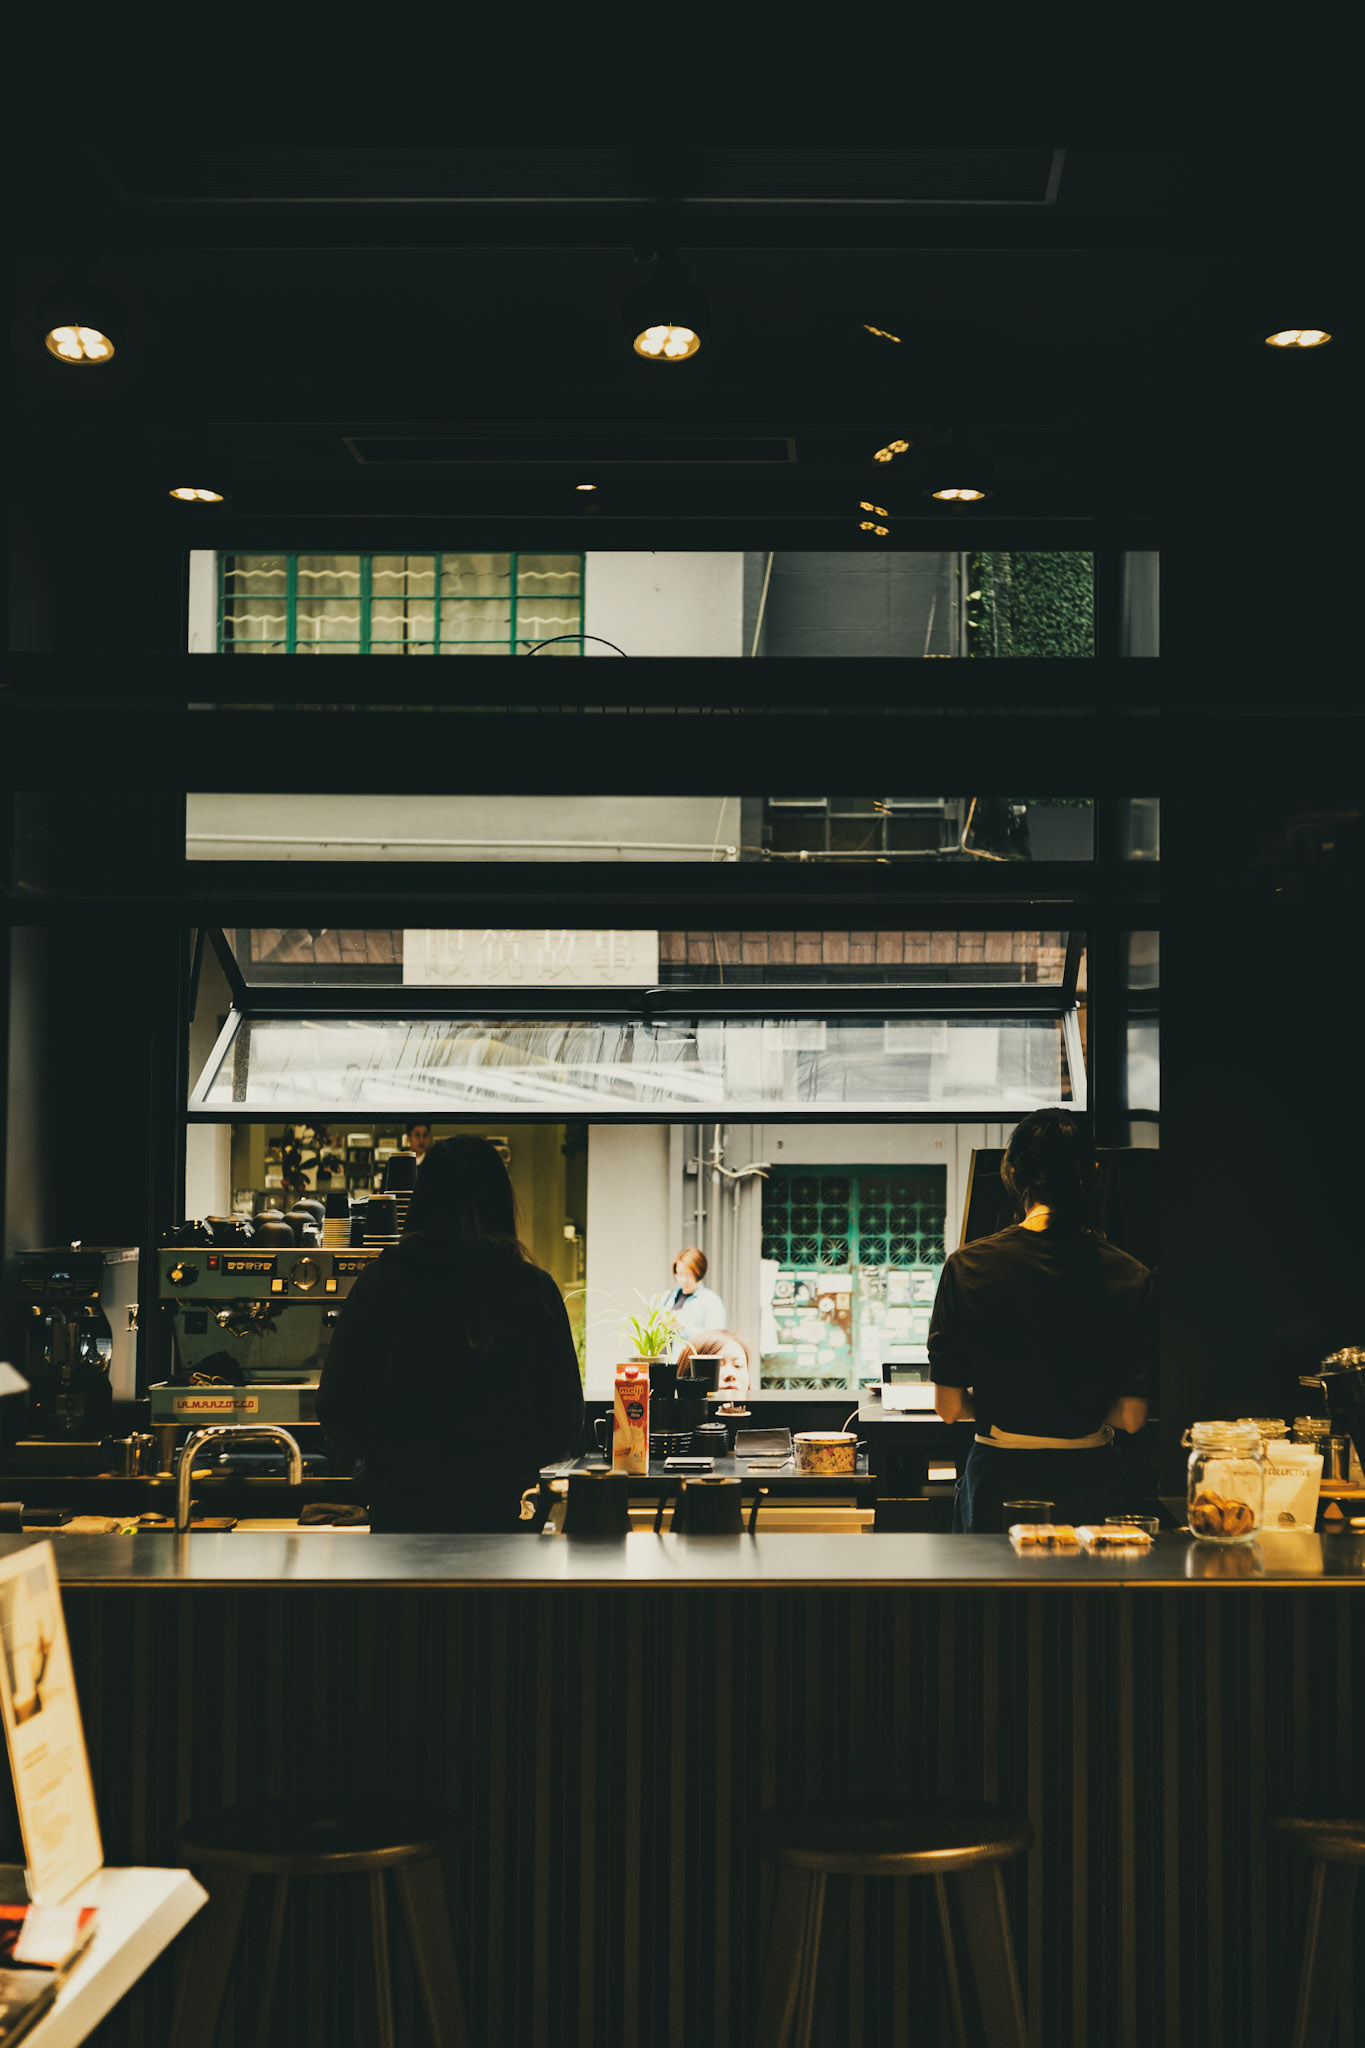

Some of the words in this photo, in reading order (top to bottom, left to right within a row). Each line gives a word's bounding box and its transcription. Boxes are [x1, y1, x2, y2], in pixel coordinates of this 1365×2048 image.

[776, 1140, 785, 1150] 9
[620, 1385, 643, 1396] meiji
[191, 1401, 254, 1409] MARZOCCO
